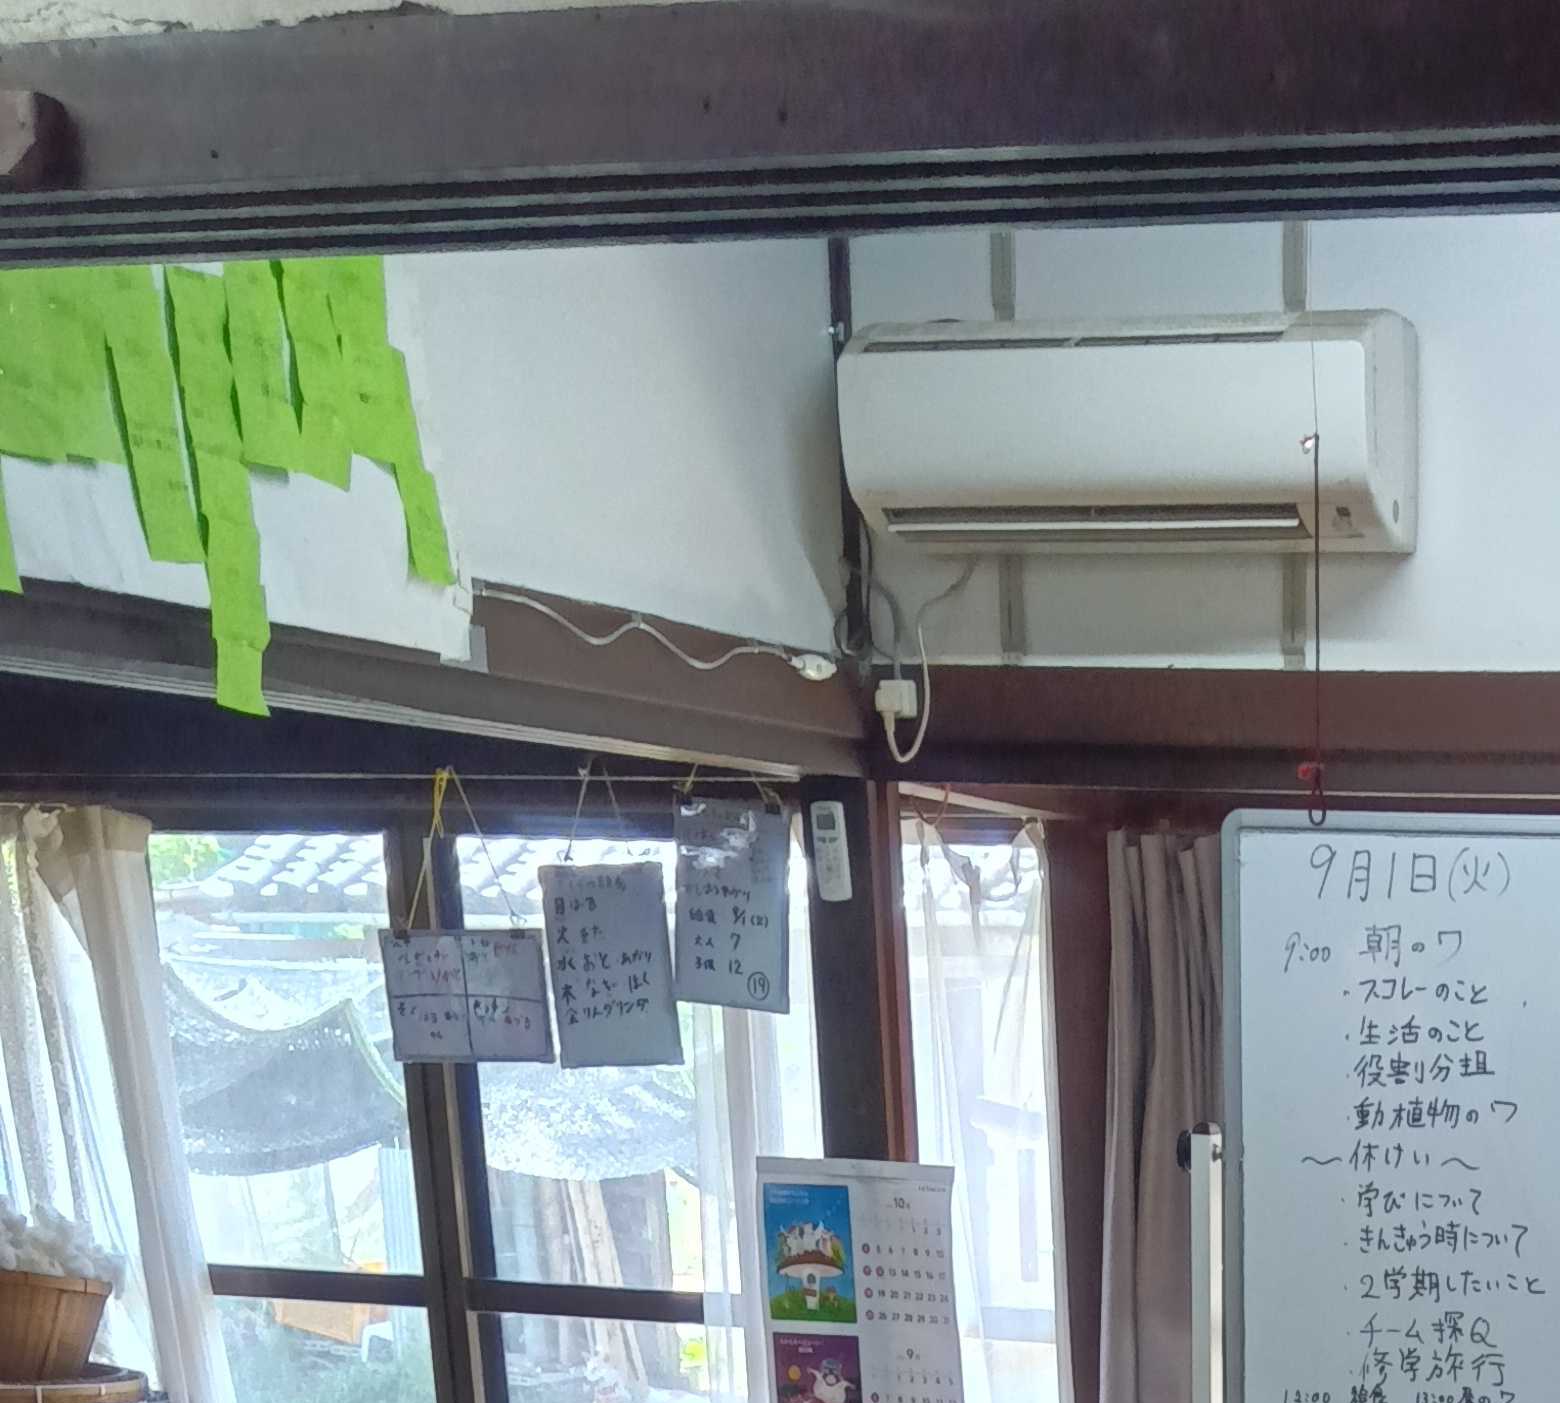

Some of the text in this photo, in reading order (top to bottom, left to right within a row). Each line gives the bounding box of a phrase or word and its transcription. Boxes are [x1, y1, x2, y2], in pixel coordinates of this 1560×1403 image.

[730, 932, 742, 950] 7
[1357, 923, 1463, 969] 朝のワ
[728, 958, 744, 976] 12
[1359, 1013, 1485, 1046] 生活のこと
[1352, 1095, 1519, 1132] 動植物のワ
